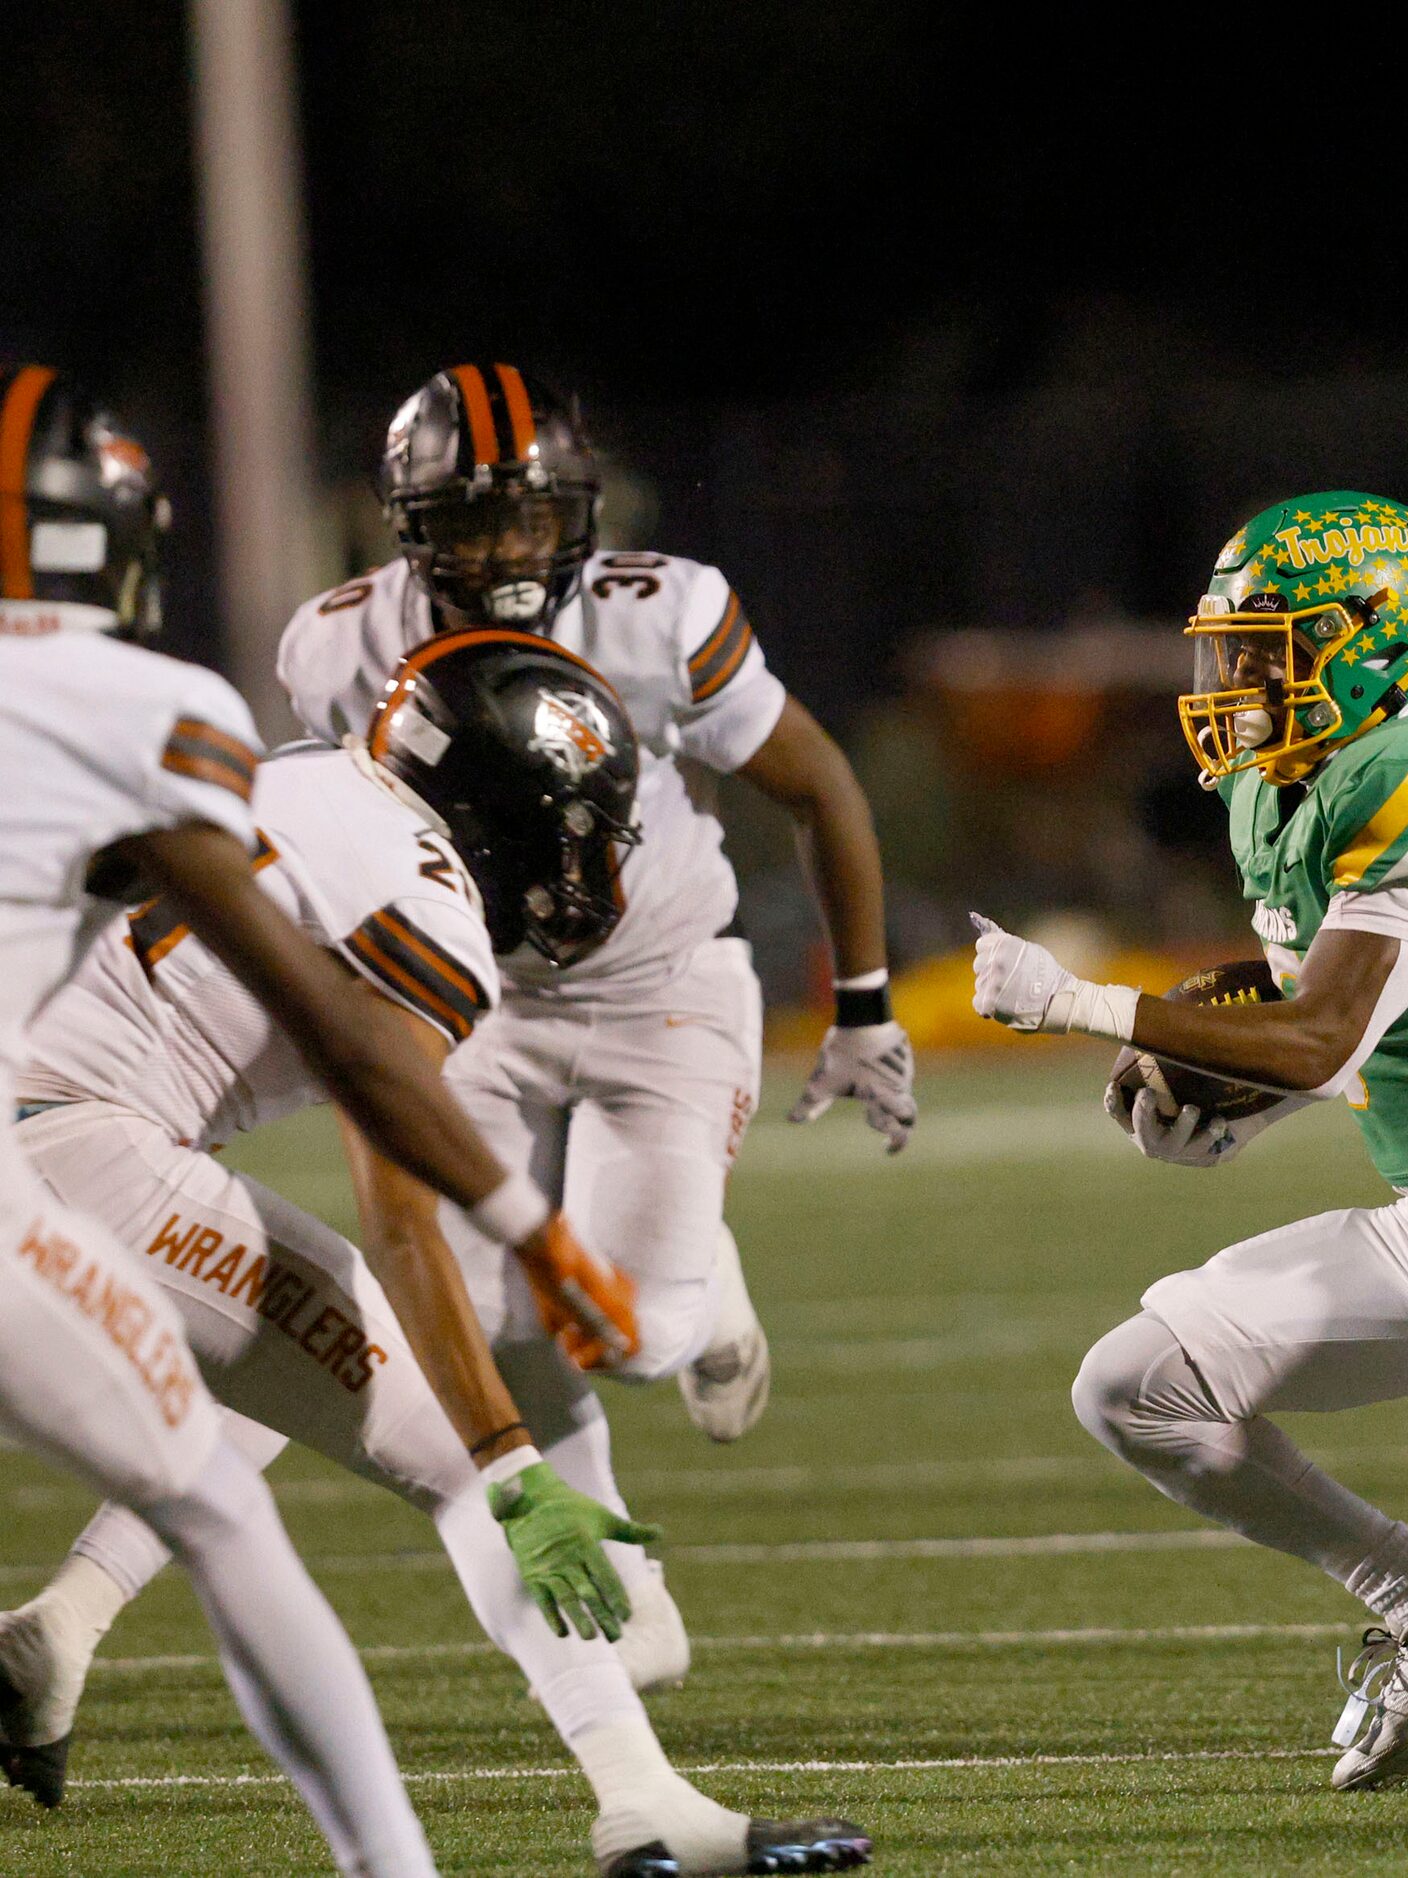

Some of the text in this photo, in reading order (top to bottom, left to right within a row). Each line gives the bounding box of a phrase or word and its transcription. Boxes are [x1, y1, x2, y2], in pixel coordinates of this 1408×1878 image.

[591, 552, 670, 600] 30
[416, 838, 474, 905] 2
[146, 1212, 389, 1394] WRANGLERS
